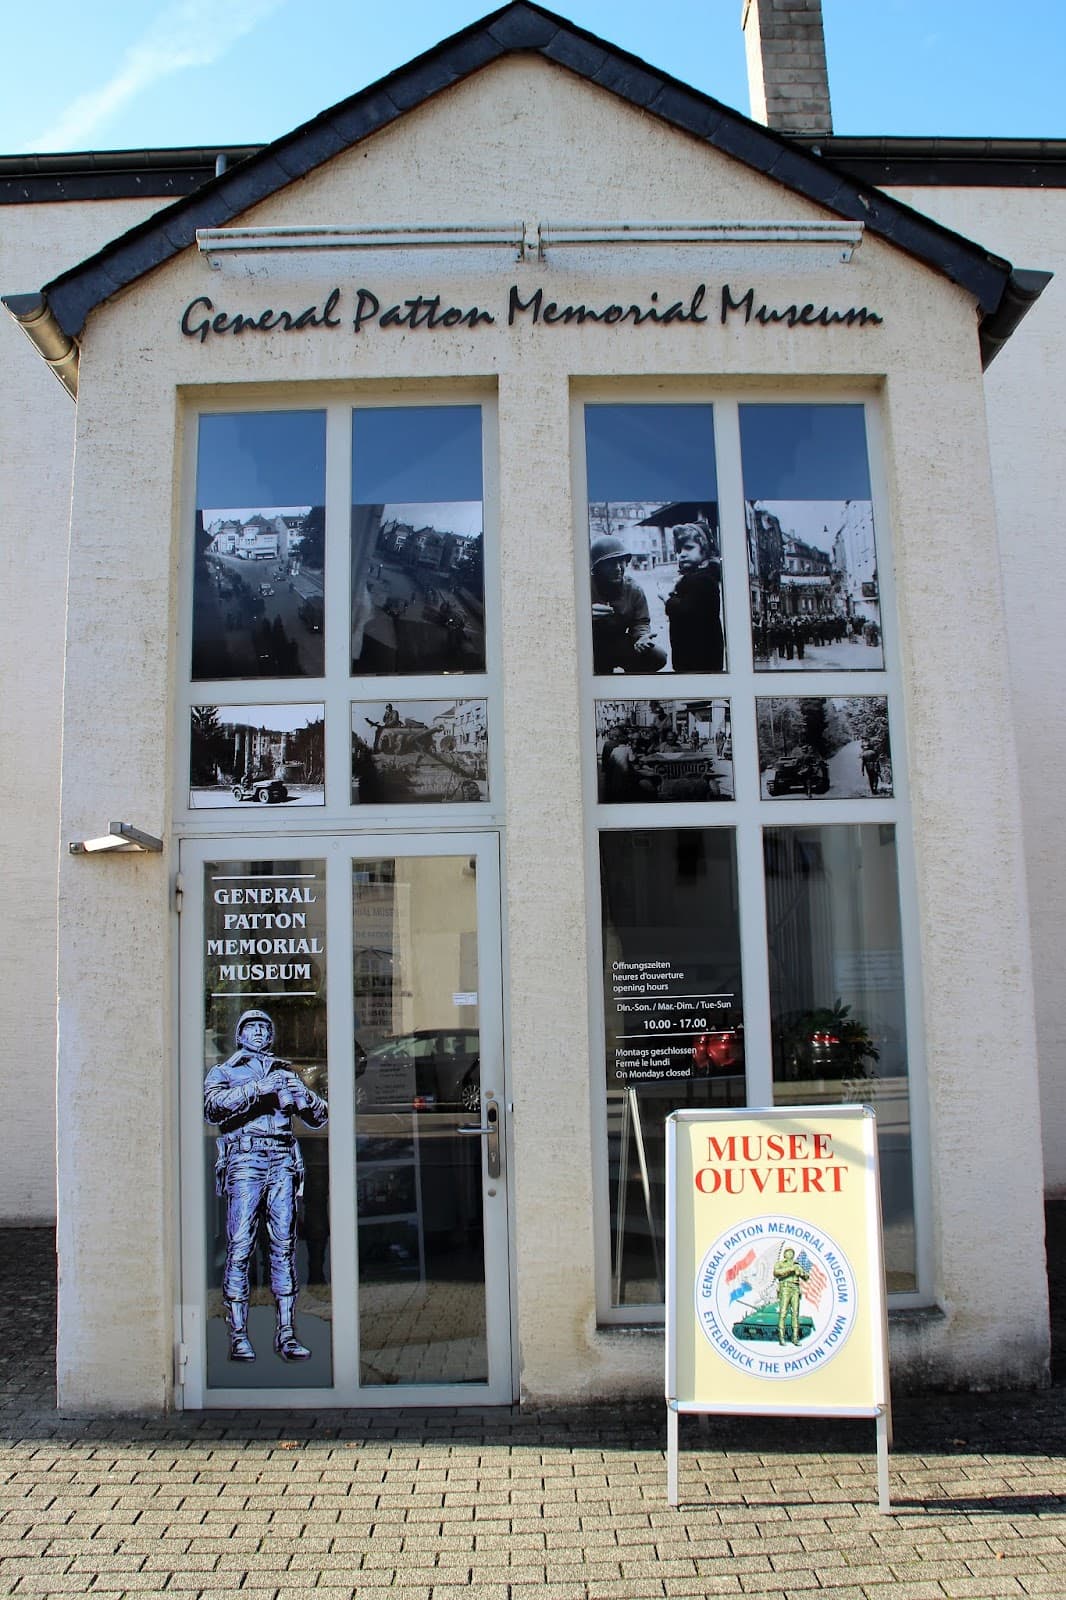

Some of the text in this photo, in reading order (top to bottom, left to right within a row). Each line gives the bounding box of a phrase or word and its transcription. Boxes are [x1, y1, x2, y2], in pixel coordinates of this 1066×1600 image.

[181, 284, 883, 343] General Patton Memorial Museum
[214, 887, 317, 905] GENERAL
[223, 912, 306, 930] PATTON
[207, 938, 324, 955] MEMORIAL
[220, 963, 311, 981] MUSEUM
[612, 961, 671, 972] Öffnungszeiten
[612, 971, 685, 981] heures d'ouverture
[613, 983, 669, 993] opening hours
[657, 1001, 695, 1011] Mar.-Dim.
[700, 1000, 732, 1009] Tue-Sun
[643, 1019, 671, 1030] 10.00
[679, 1018, 707, 1029] 17.00
[615, 1046, 698, 1058] Montags geschlossen
[615, 1057, 671, 1068] Fermé le lundi
[615, 1067, 691, 1079] On Mondays closed
[707, 1133, 834, 1163] MUSEE
[695, 1166, 849, 1195] OUVERT
[702, 1222, 849, 1304] GENERAL PATTON MEMORIAL MUSEUM
[703, 1310, 848, 1374] ETTELBRUCK THE PATTON TOWN
